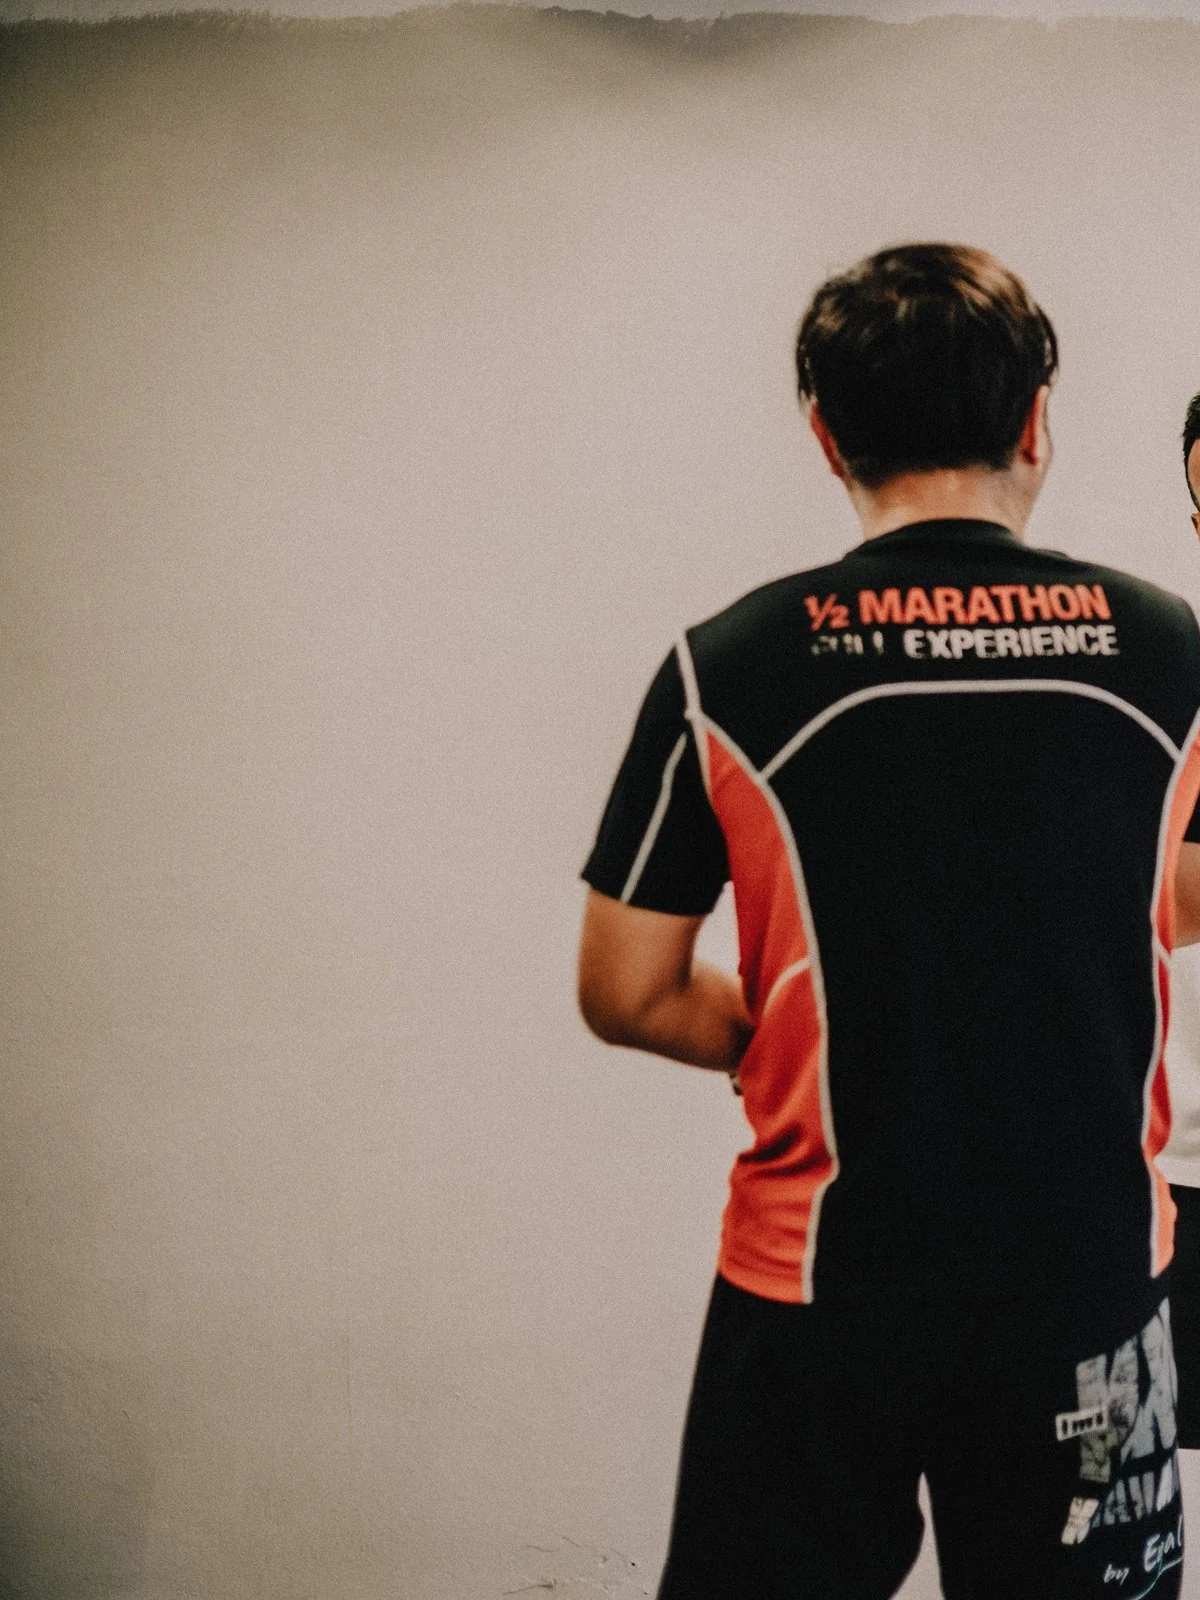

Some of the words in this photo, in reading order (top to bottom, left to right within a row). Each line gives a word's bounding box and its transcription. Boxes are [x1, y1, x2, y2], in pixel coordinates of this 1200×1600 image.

[857, 584, 1112, 625] MARATHON
[904, 624, 1119, 659] EXPERIENCE
[1103, 1563, 1130, 1585] by
